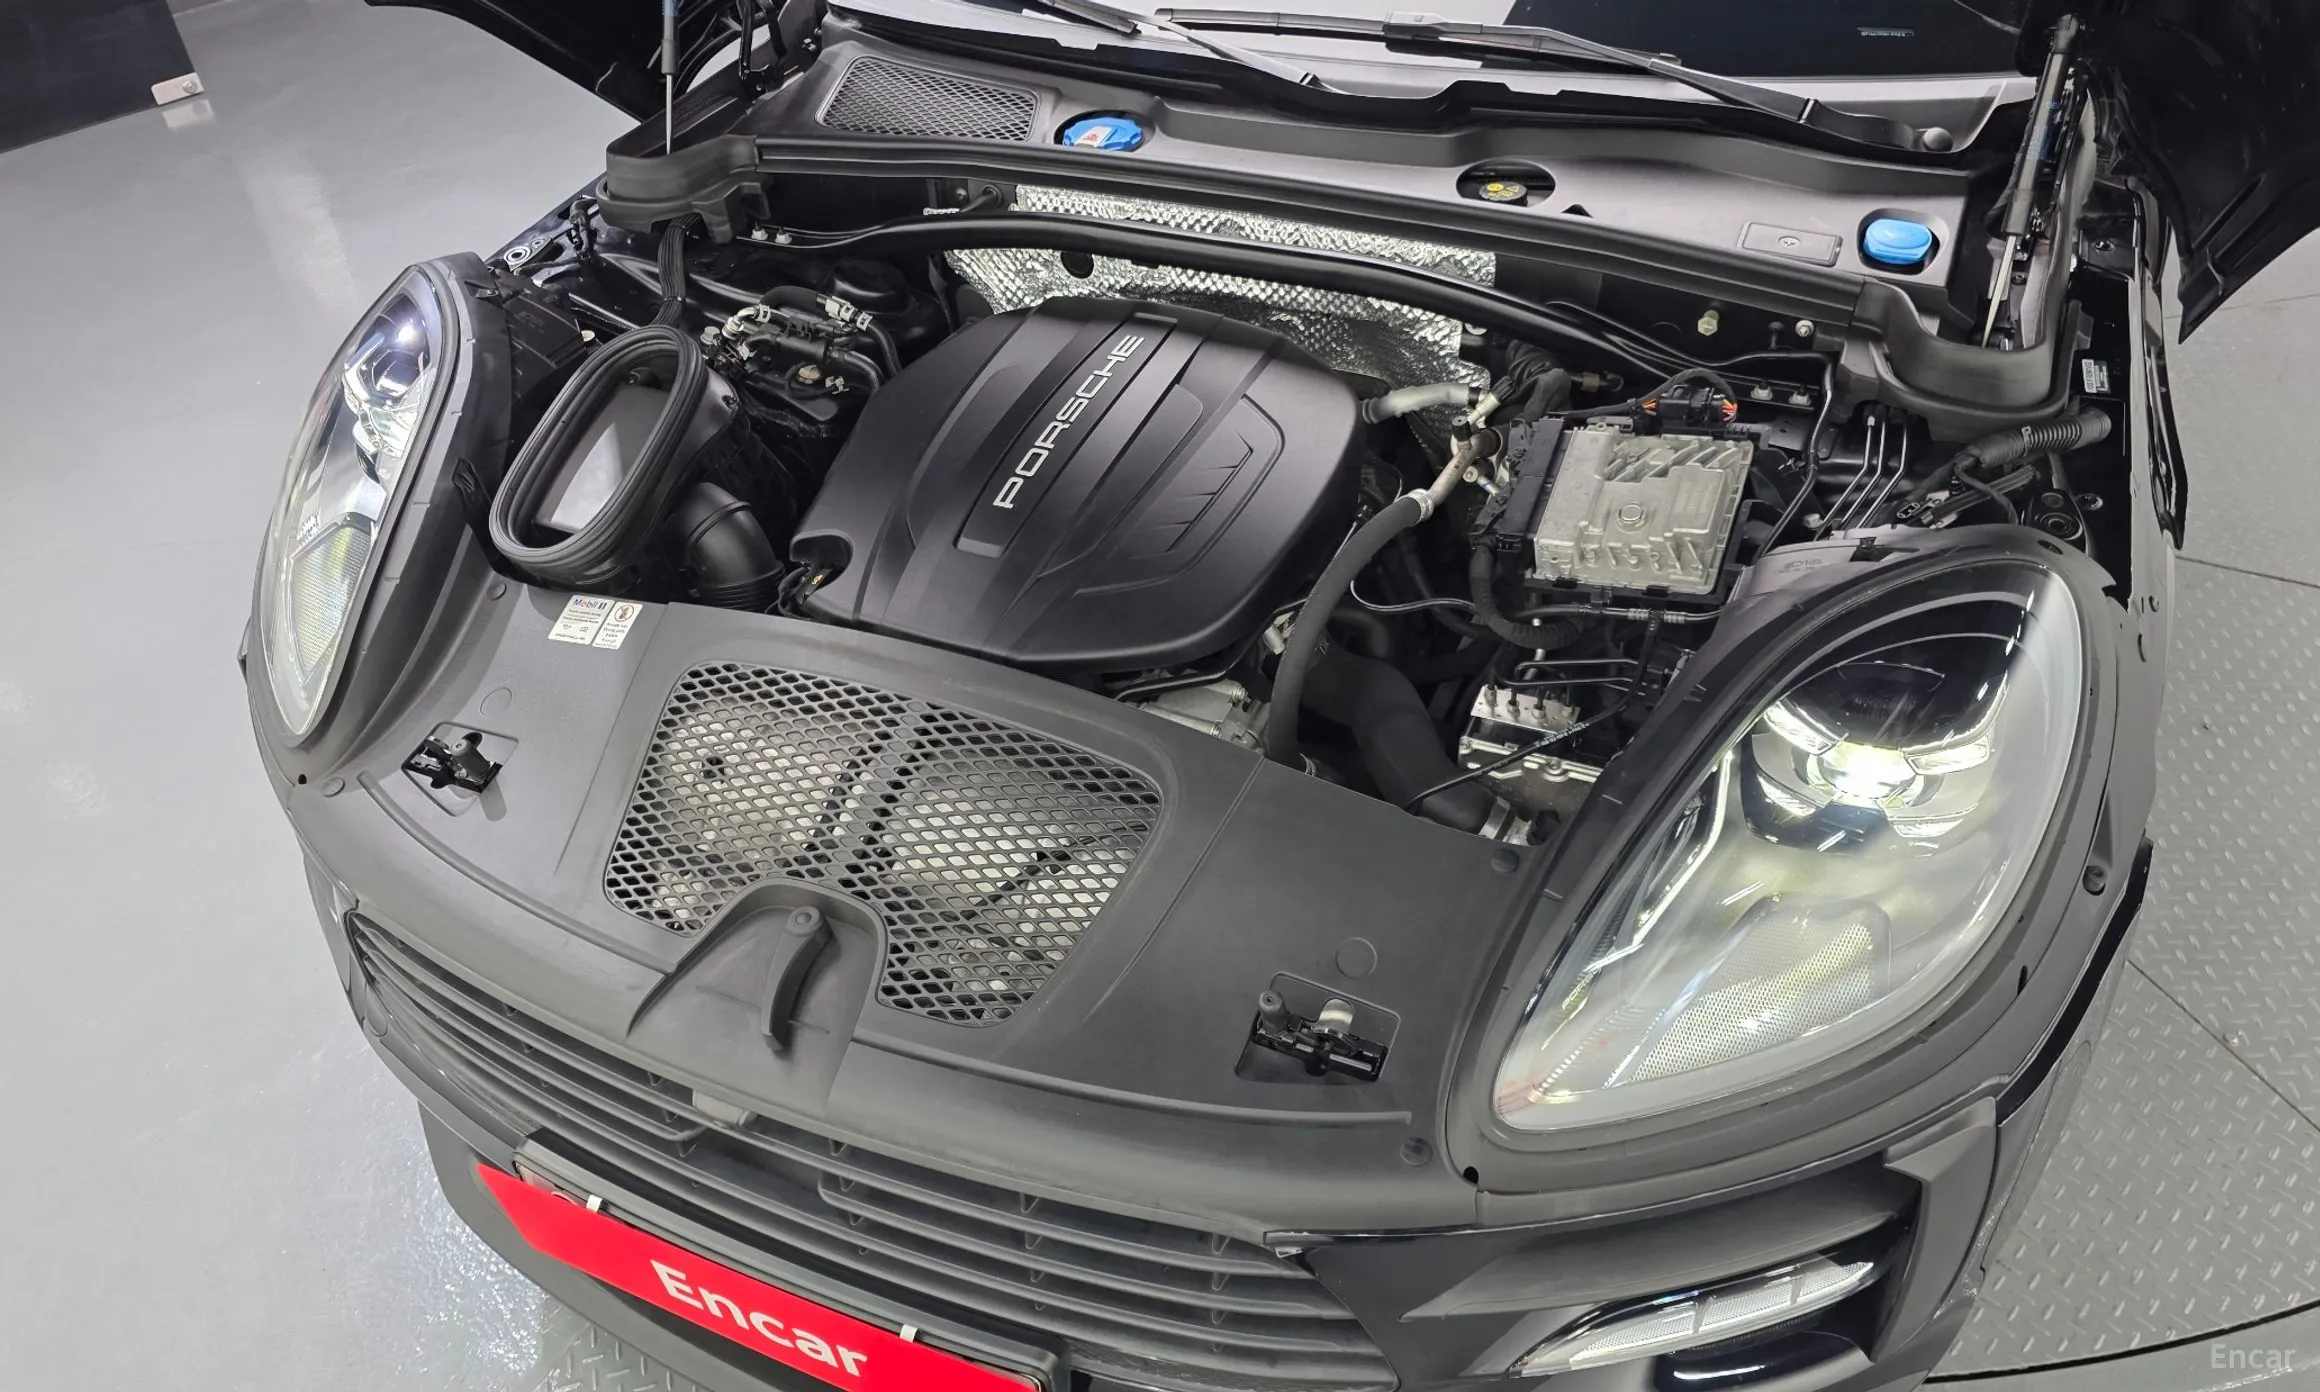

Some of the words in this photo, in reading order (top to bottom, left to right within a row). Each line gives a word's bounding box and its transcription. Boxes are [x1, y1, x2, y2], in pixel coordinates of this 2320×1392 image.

[993, 335, 1145, 509] PORSCHE
[572, 598, 598, 609] Mobil
[650, 1258, 868, 1377] Encar
